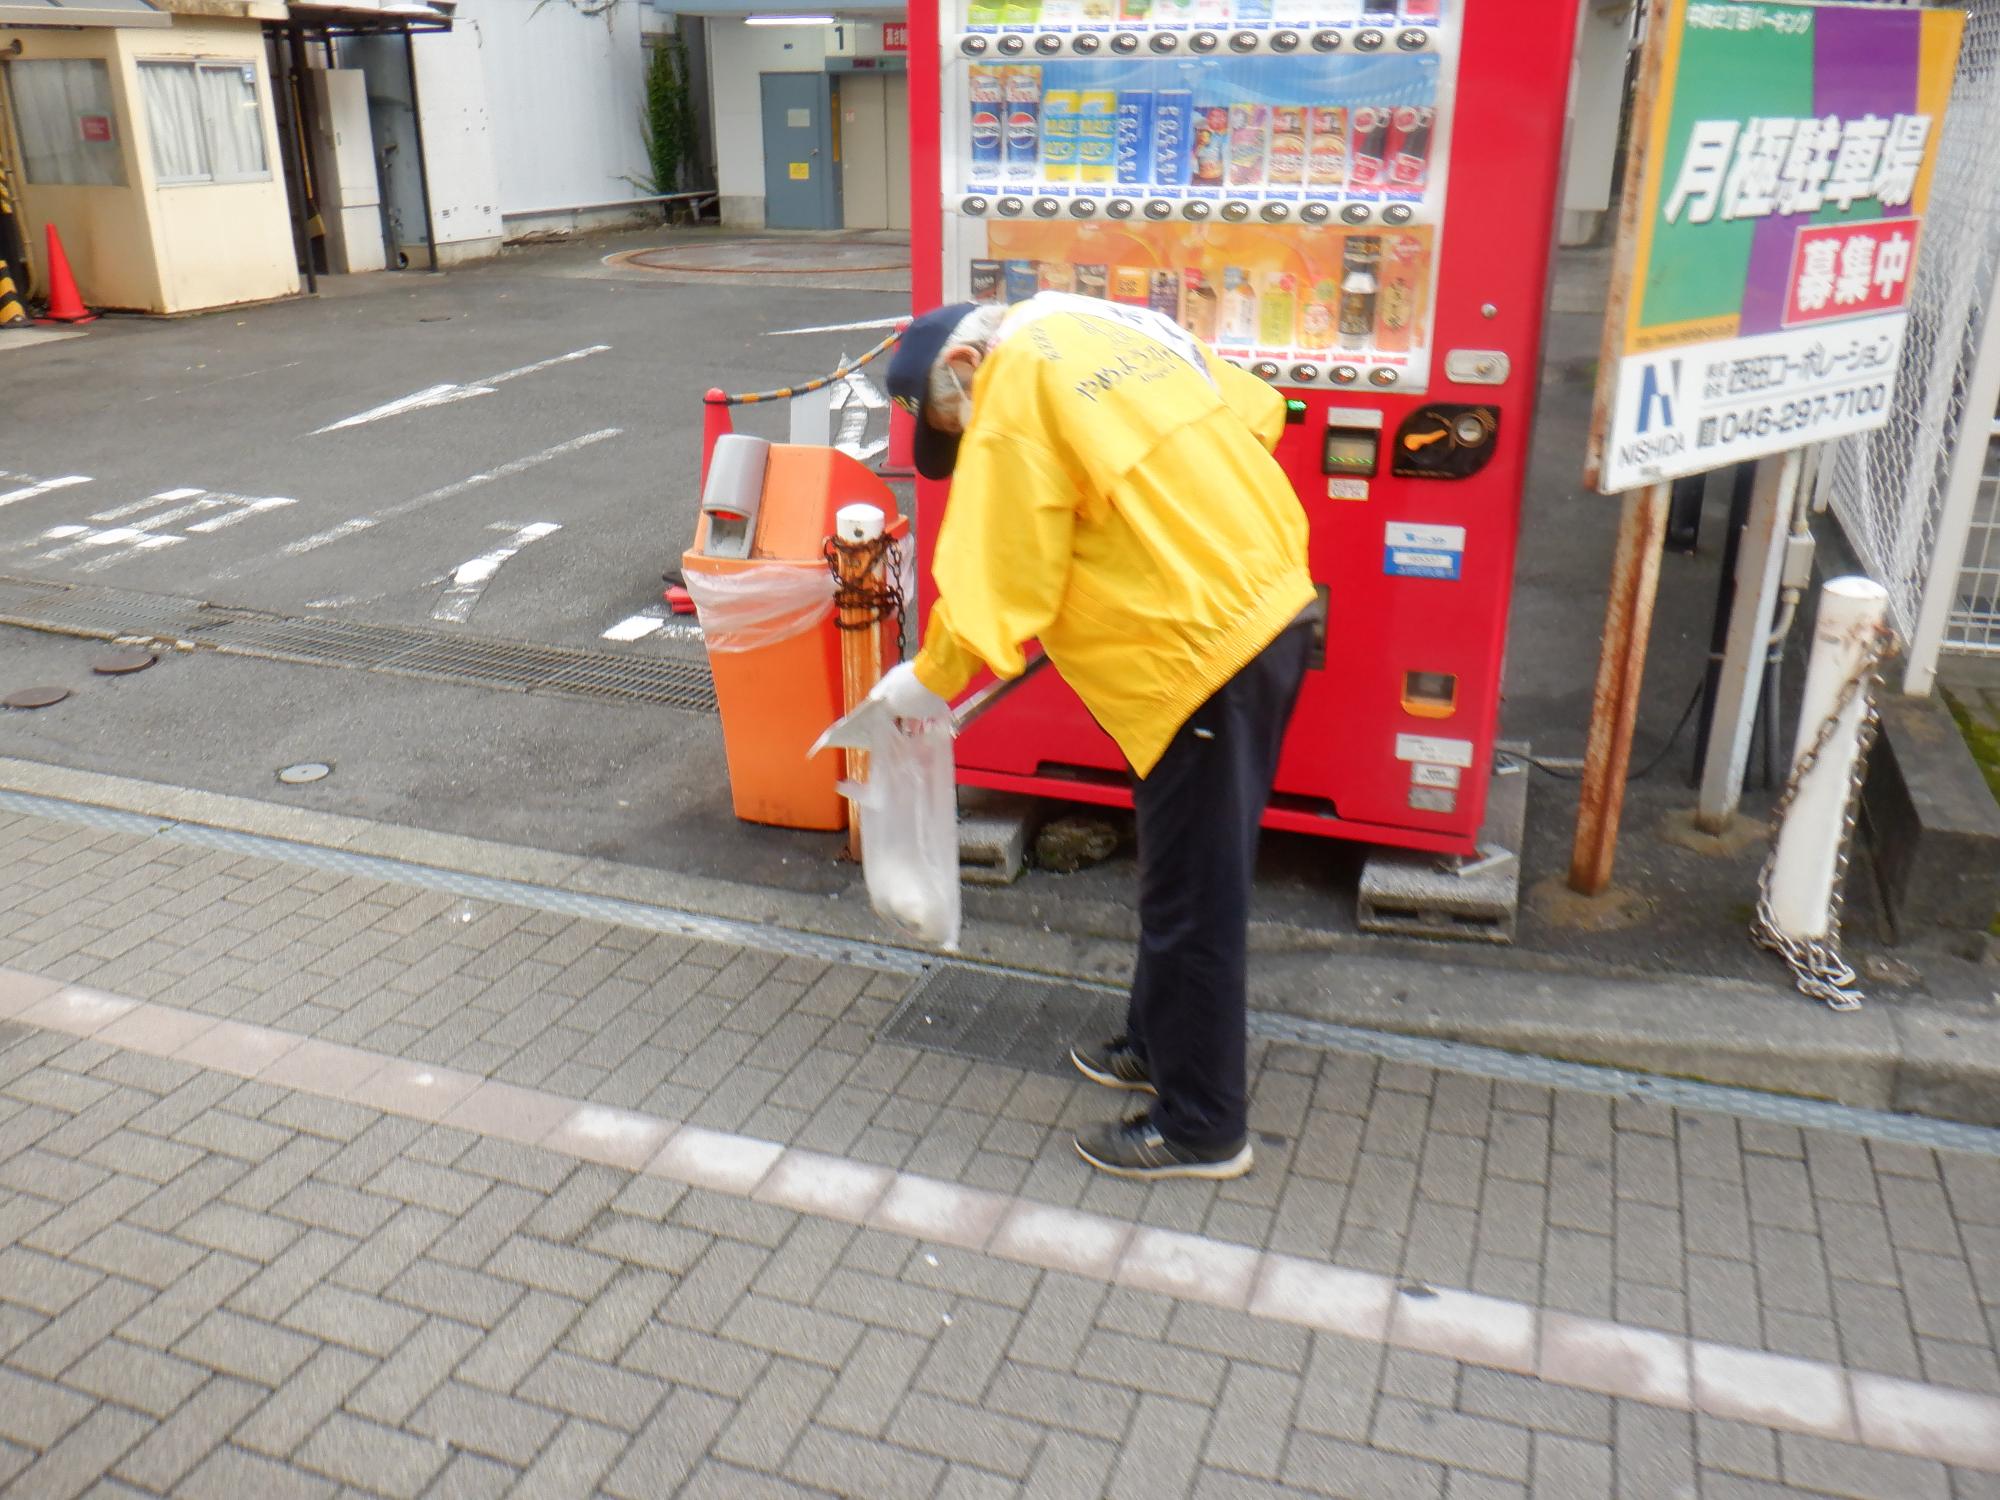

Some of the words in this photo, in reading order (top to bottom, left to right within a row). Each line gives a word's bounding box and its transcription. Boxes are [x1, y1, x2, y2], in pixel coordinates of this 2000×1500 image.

[1663, 114, 1931, 224] 月極駐車場
[1797, 231, 1911, 312] 募集中
[1617, 432, 1686, 466] NISHIDA
[1720, 383, 1886, 444] 046-297-7100
